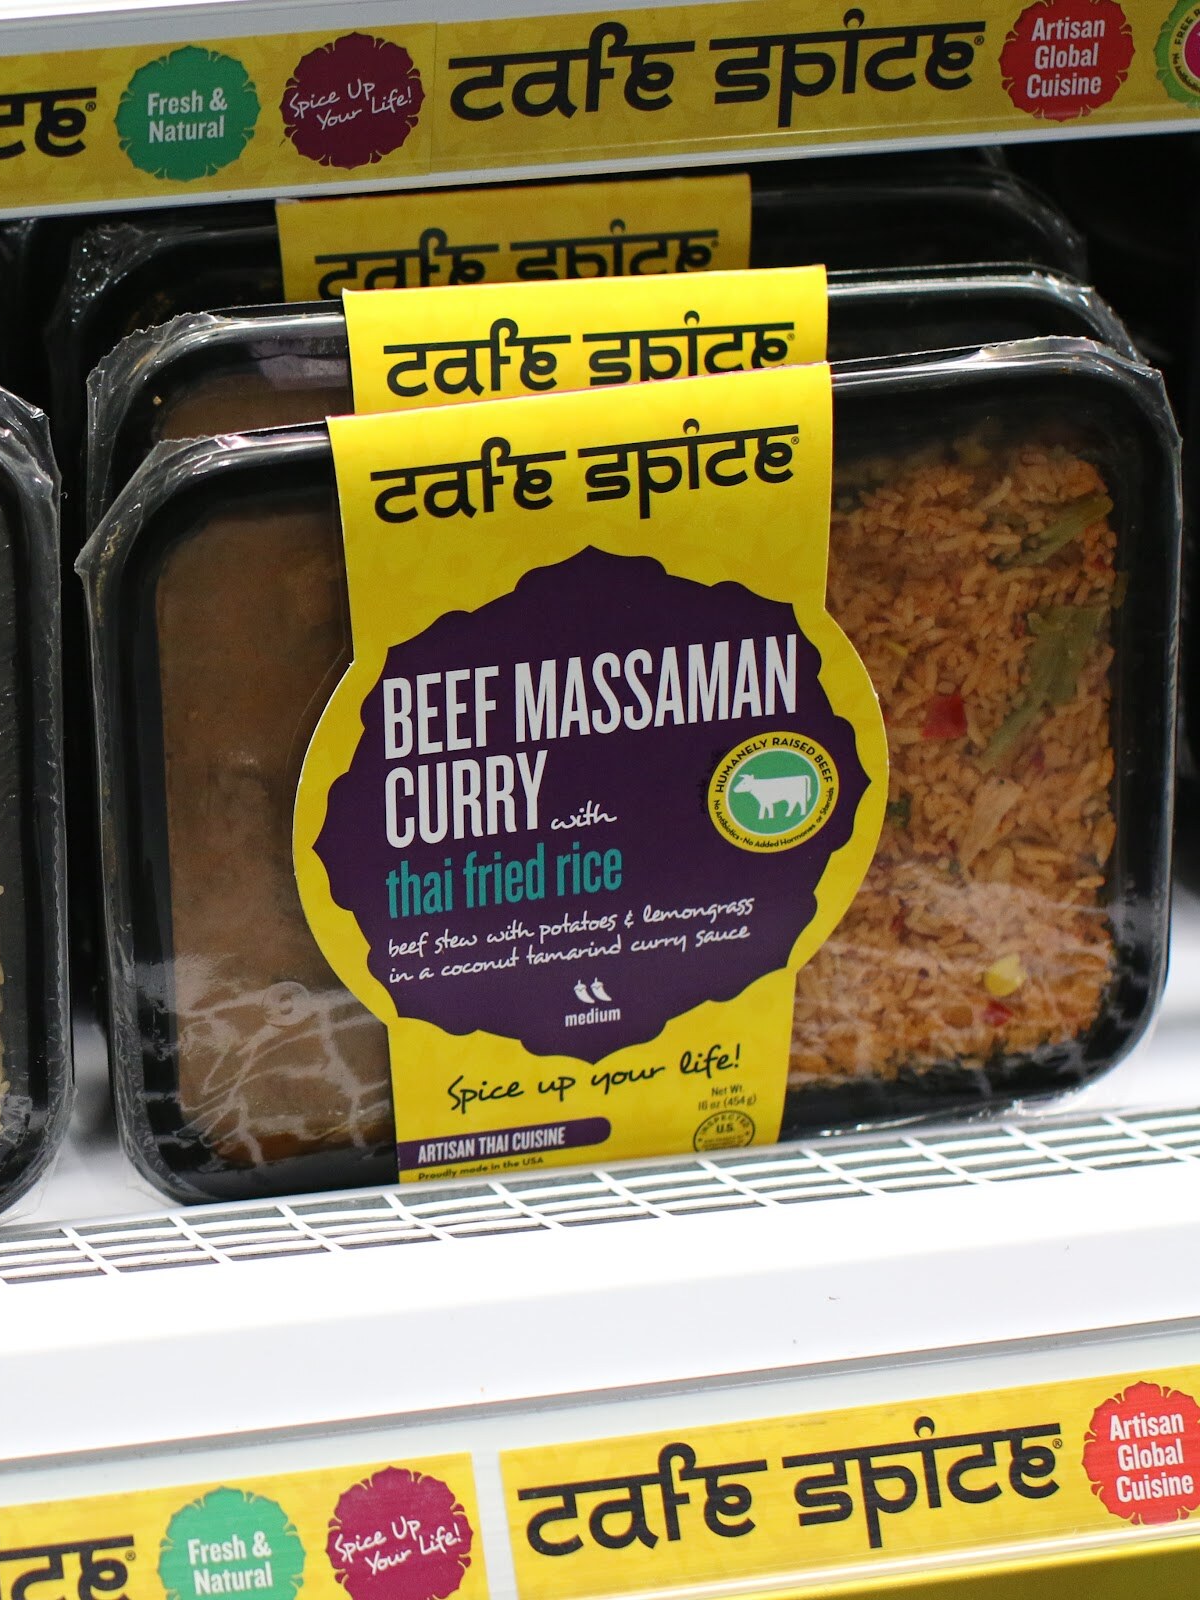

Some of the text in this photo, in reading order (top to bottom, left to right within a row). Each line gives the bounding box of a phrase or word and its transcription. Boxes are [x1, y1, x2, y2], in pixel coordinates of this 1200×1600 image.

[1031, 16, 1106, 41] Artisan
[448, 21, 695, 121] cafe
[1034, 42, 1100, 70] Global
[147, 87, 228, 117] Fresh &
[289, 78, 376, 119] Spice Up
[1026, 73, 1102, 99] Cuisine
[316, 86, 412, 130] Your Life!
[148, 116, 225, 144] Natural
[383, 317, 571, 397] cafe
[370, 436, 566, 524] cafe
[382, 633, 798, 761] BEEF MASSAMAN
[715, 737, 833, 793] HUMANELY RAISED BEEF
[384, 749, 617, 849] CURRY with
[384, 841, 623, 920] thai fried rice
[388, 897, 755, 959] beef stew with potatoes & lemongrass
[389, 923, 752, 984] in a coconut tamarind curry sauce
[564, 1006, 622, 1028] medium
[446, 1043, 741, 1115] Spice up your life!
[711, 1086, 727, 1097] Net
[417, 1126, 566, 1164] ARTISAN THAI CUISINE
[418, 1156, 544, 1181] Proudly made in the USA
[1109, 1411, 1185, 1442] Artisan
[1117, 1438, 1184, 1472] Global
[517, 1441, 768, 1557] cafe
[1115, 1471, 1195, 1503] Cuisine
[187, 1530, 272, 1566] Fresh &
[334, 1515, 421, 1564] Spice Up
[365, 1522, 462, 1576] Your Life!
[193, 1561, 273, 1596] Natural
